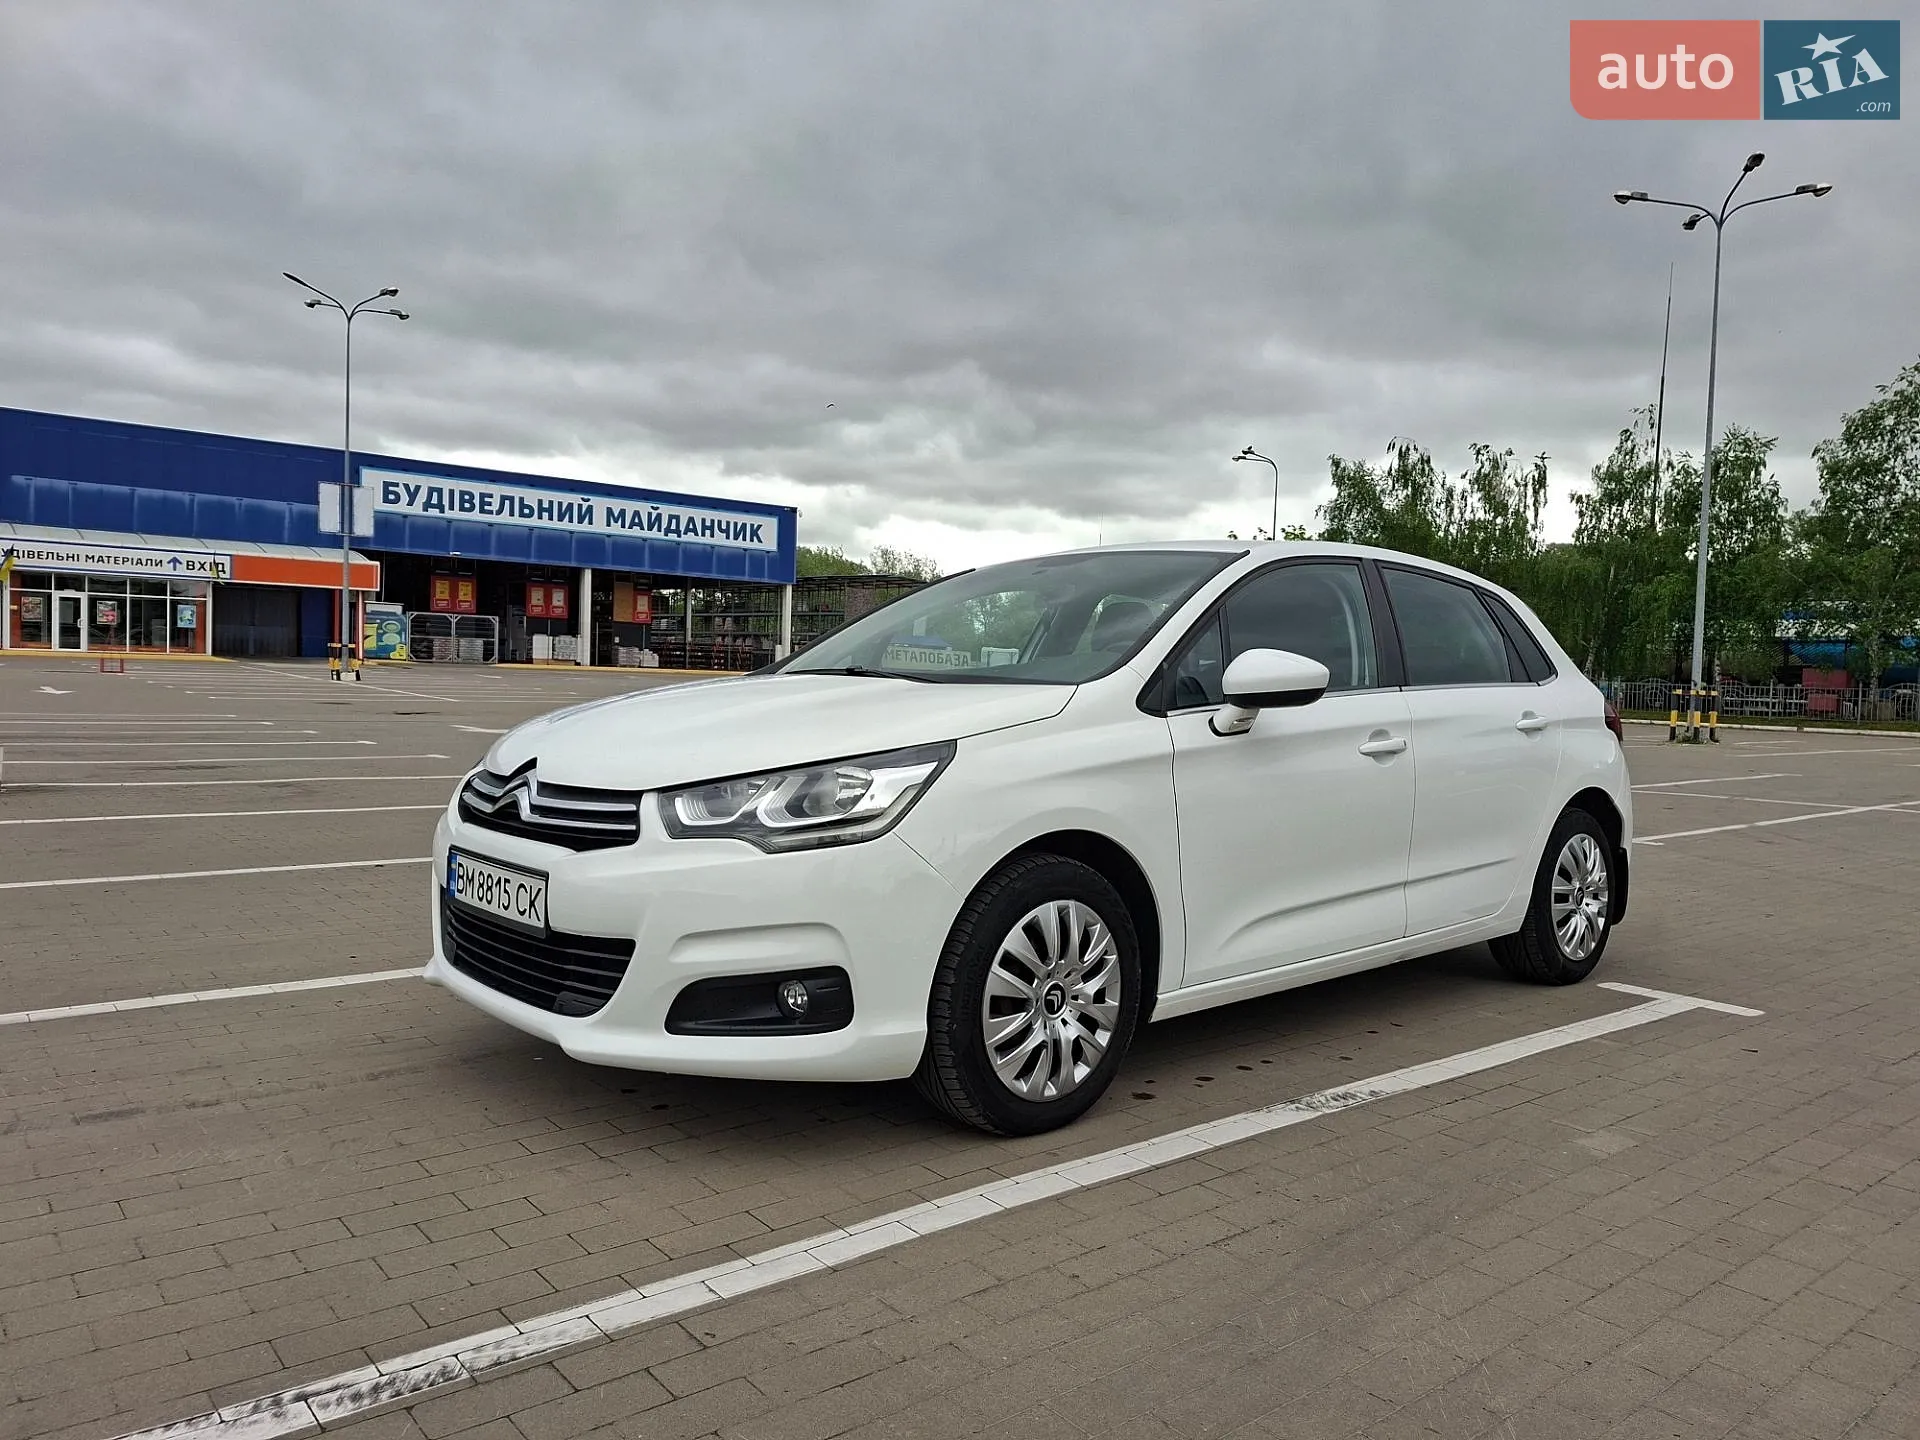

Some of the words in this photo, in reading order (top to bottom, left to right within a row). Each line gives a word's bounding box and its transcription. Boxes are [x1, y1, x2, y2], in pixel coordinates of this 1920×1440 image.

[382, 480, 594, 526] БУДІВЕЛЬНИЙ
[605, 505, 763, 543] МАЙДАНЧИК
[85, 554, 163, 567] МАТЕРІАЛИ
[186, 560, 226, 574] ВХІД
[456, 861, 475, 899] BM
[477, 870, 511, 911] 8815
[516, 882, 543, 922] CK
